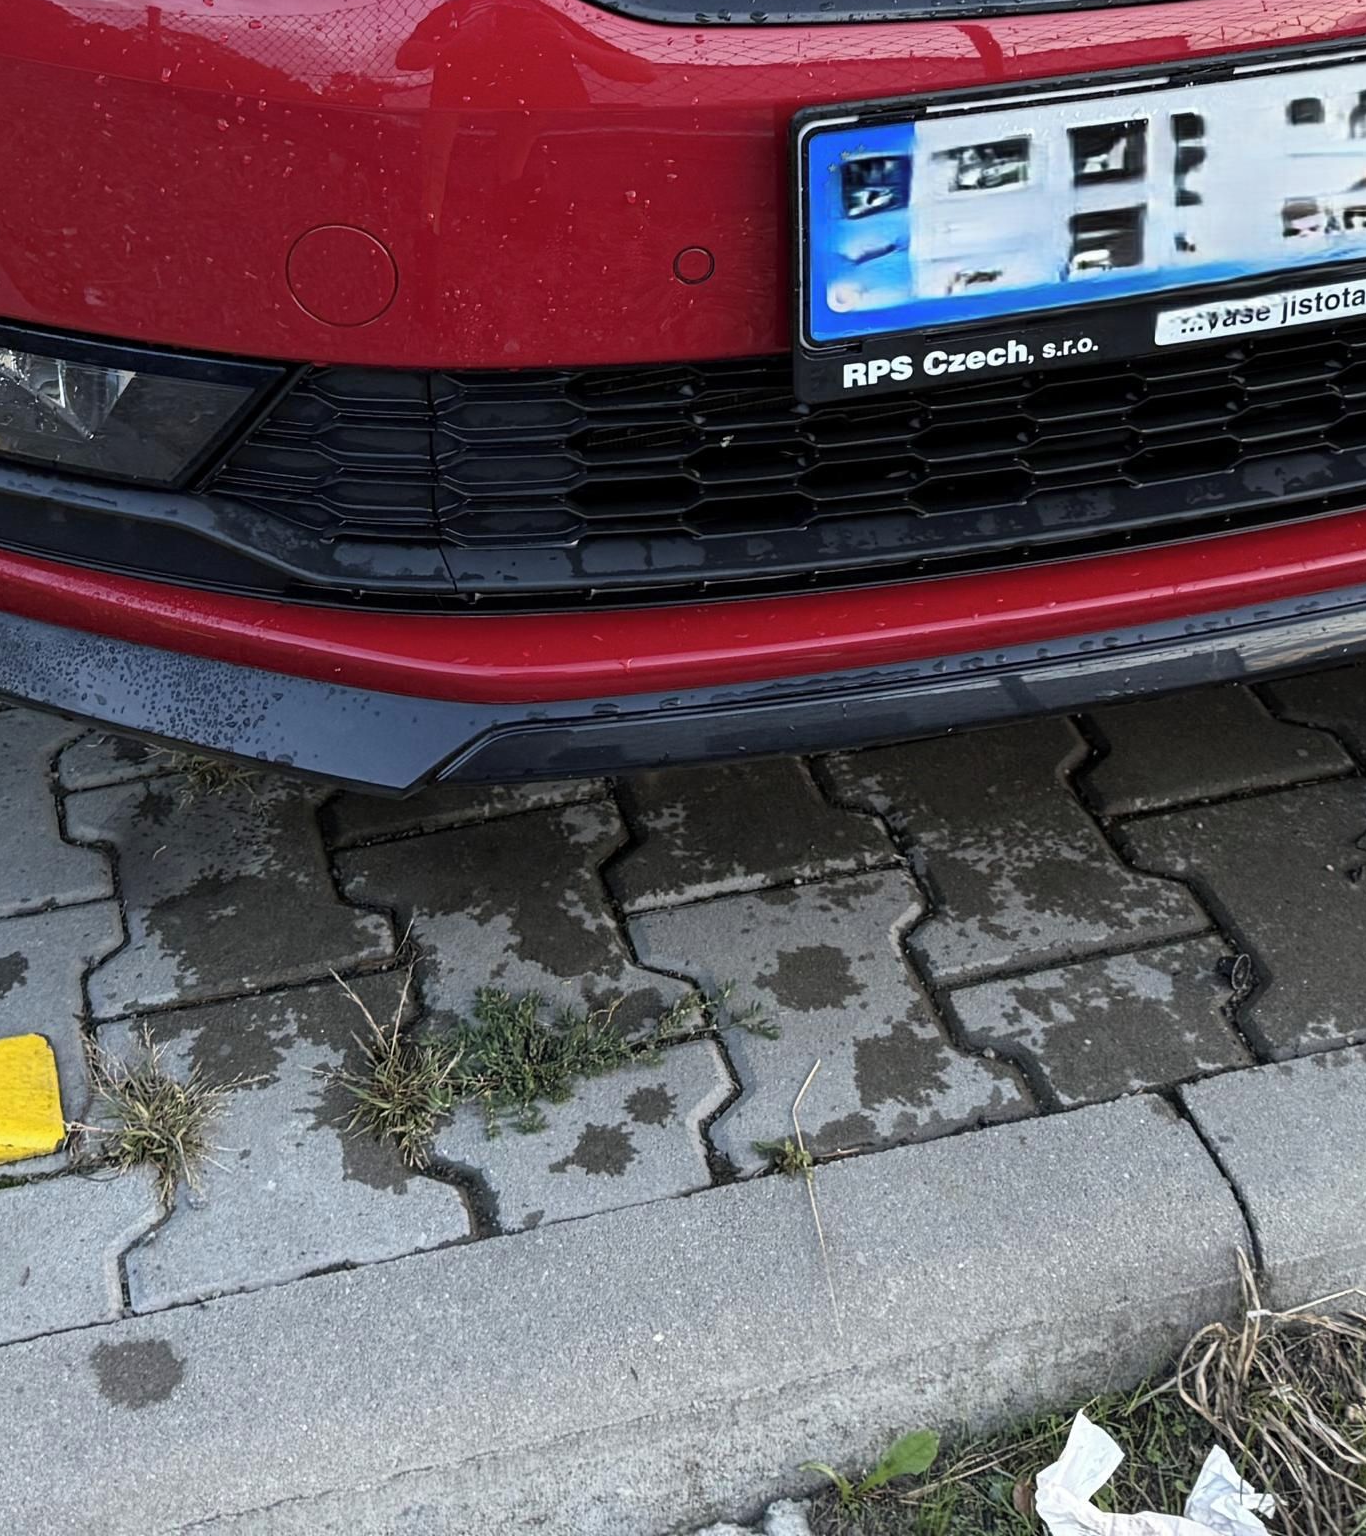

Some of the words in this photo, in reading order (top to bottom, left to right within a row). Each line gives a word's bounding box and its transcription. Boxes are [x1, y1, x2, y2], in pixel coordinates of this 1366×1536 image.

[1280, 290, 1366, 324] jistota
[843, 356, 913, 388] RPS
[923, 340, 1034, 375] Czech,
[1042, 337, 1099, 358] s.r.o.
